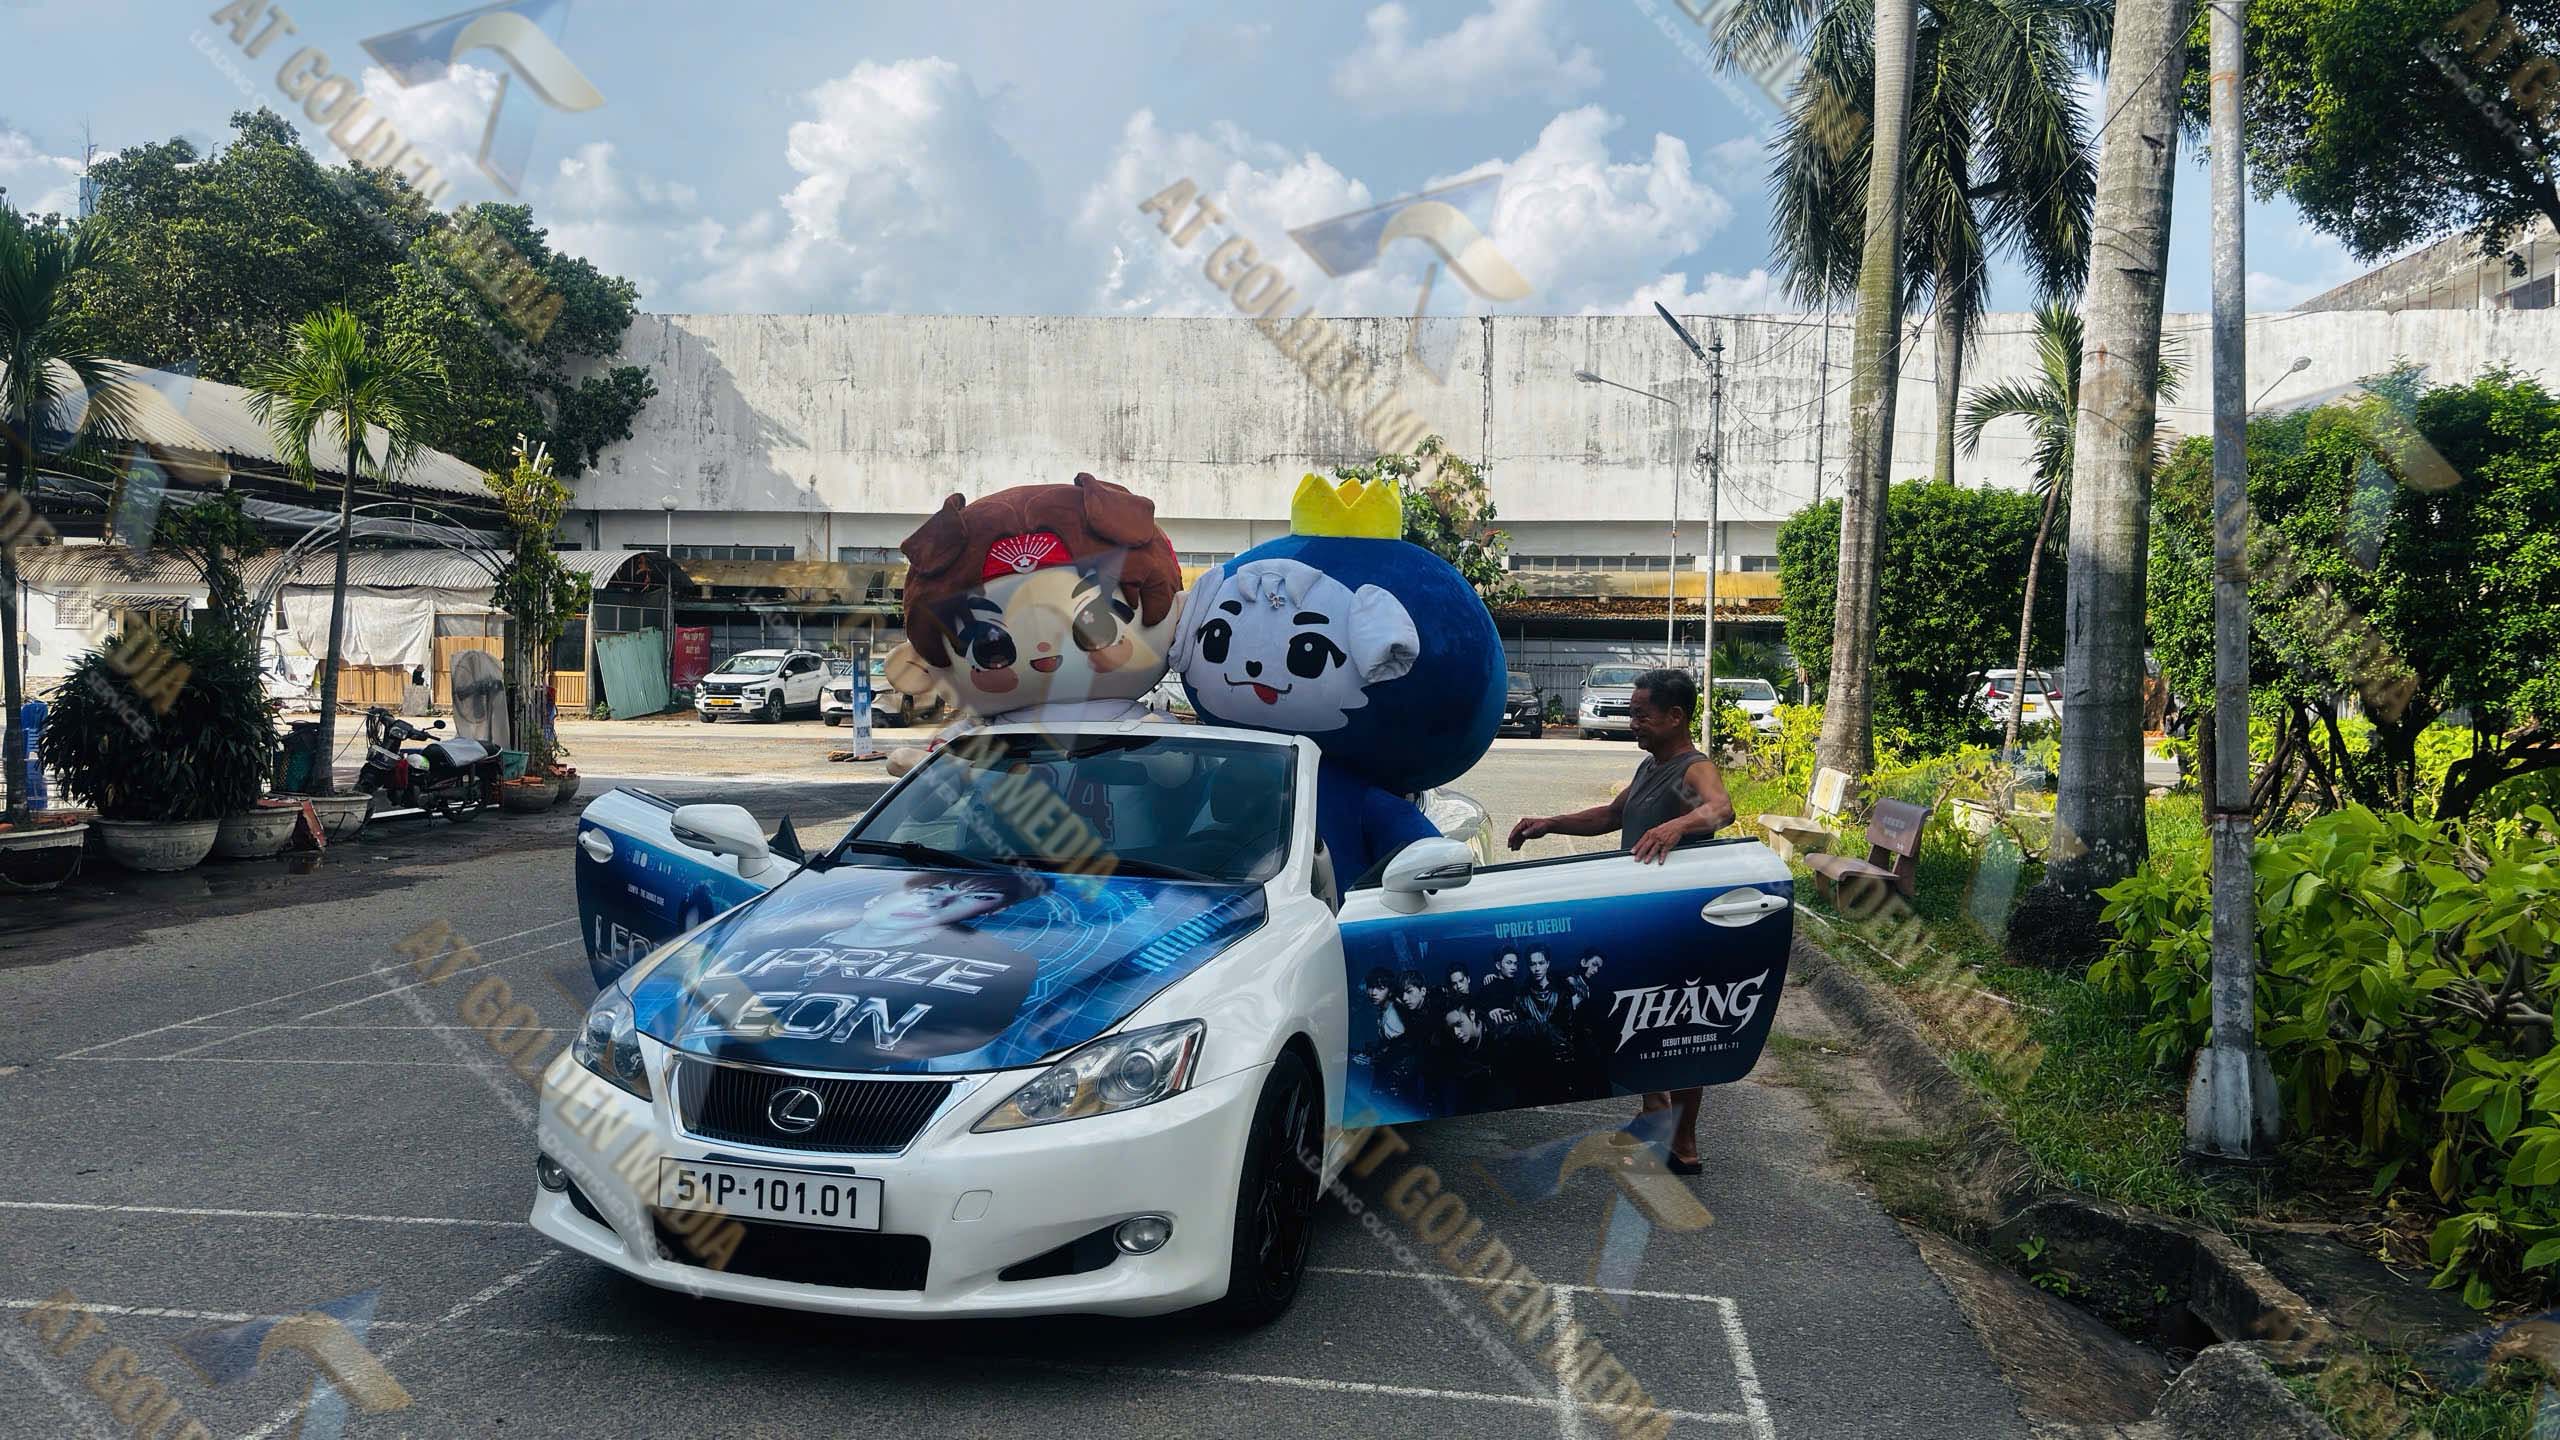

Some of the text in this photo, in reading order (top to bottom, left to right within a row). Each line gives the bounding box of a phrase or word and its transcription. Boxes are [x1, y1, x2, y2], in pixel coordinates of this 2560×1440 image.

[1536, 917, 1572, 935] DEBUT
[700, 948, 1012, 994] UPRIZE
[686, 991, 933, 1051] LEON
[1608, 968, 1770, 1053] THĂNG
[1662, 1038, 1681, 1048] DEBUT
[1693, 1033, 1718, 1044] RELEASE
[677, 1169, 858, 1219] 51P-101.01
